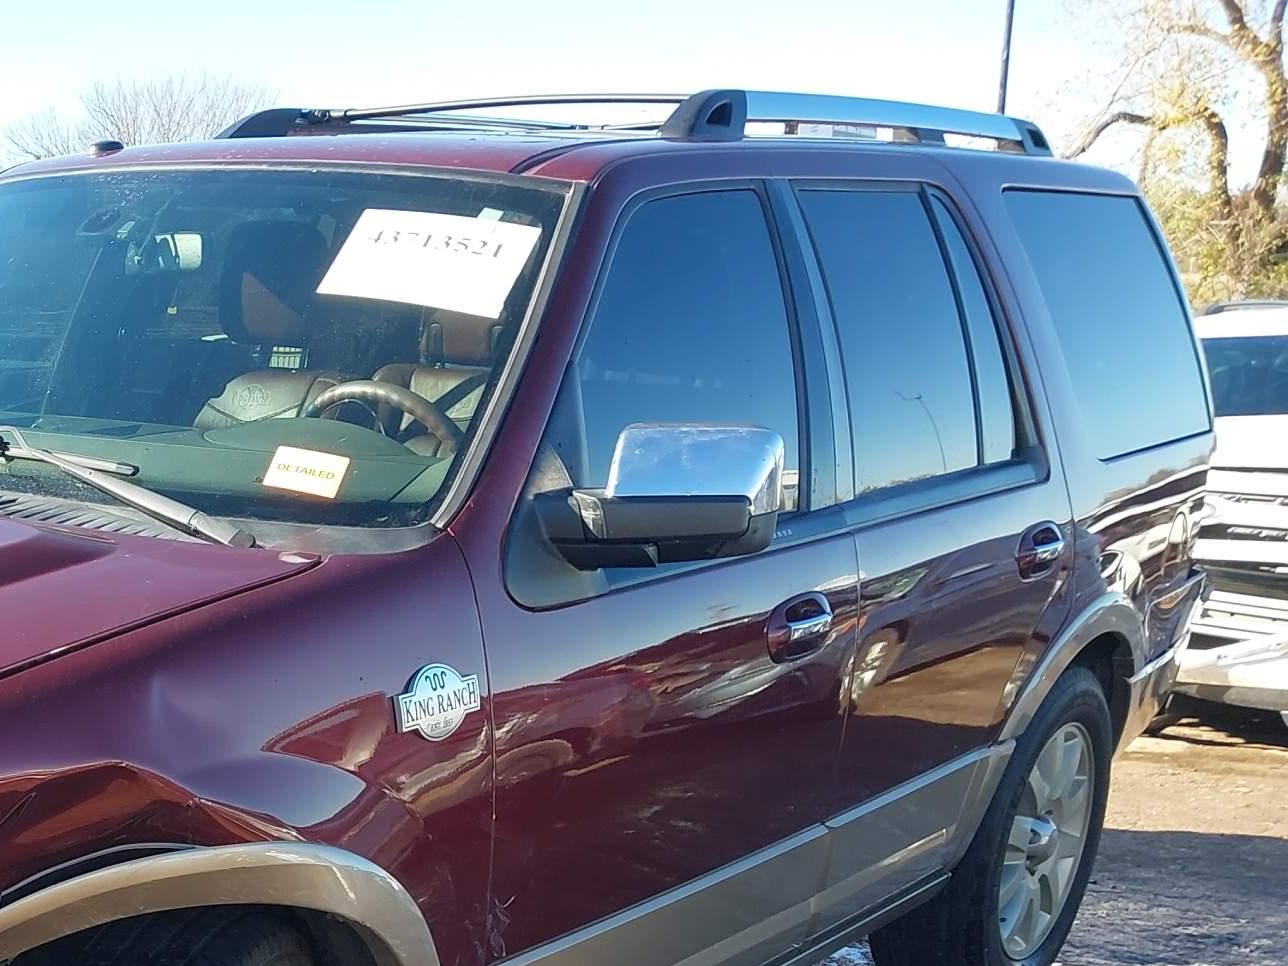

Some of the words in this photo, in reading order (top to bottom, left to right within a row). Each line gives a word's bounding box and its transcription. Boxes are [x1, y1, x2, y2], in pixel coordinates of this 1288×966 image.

[368, 230, 504, 258] 43713521
[276, 463, 336, 480] DETAILED
[404, 697, 435, 723] KING
[437, 681, 477, 714] RANCH
